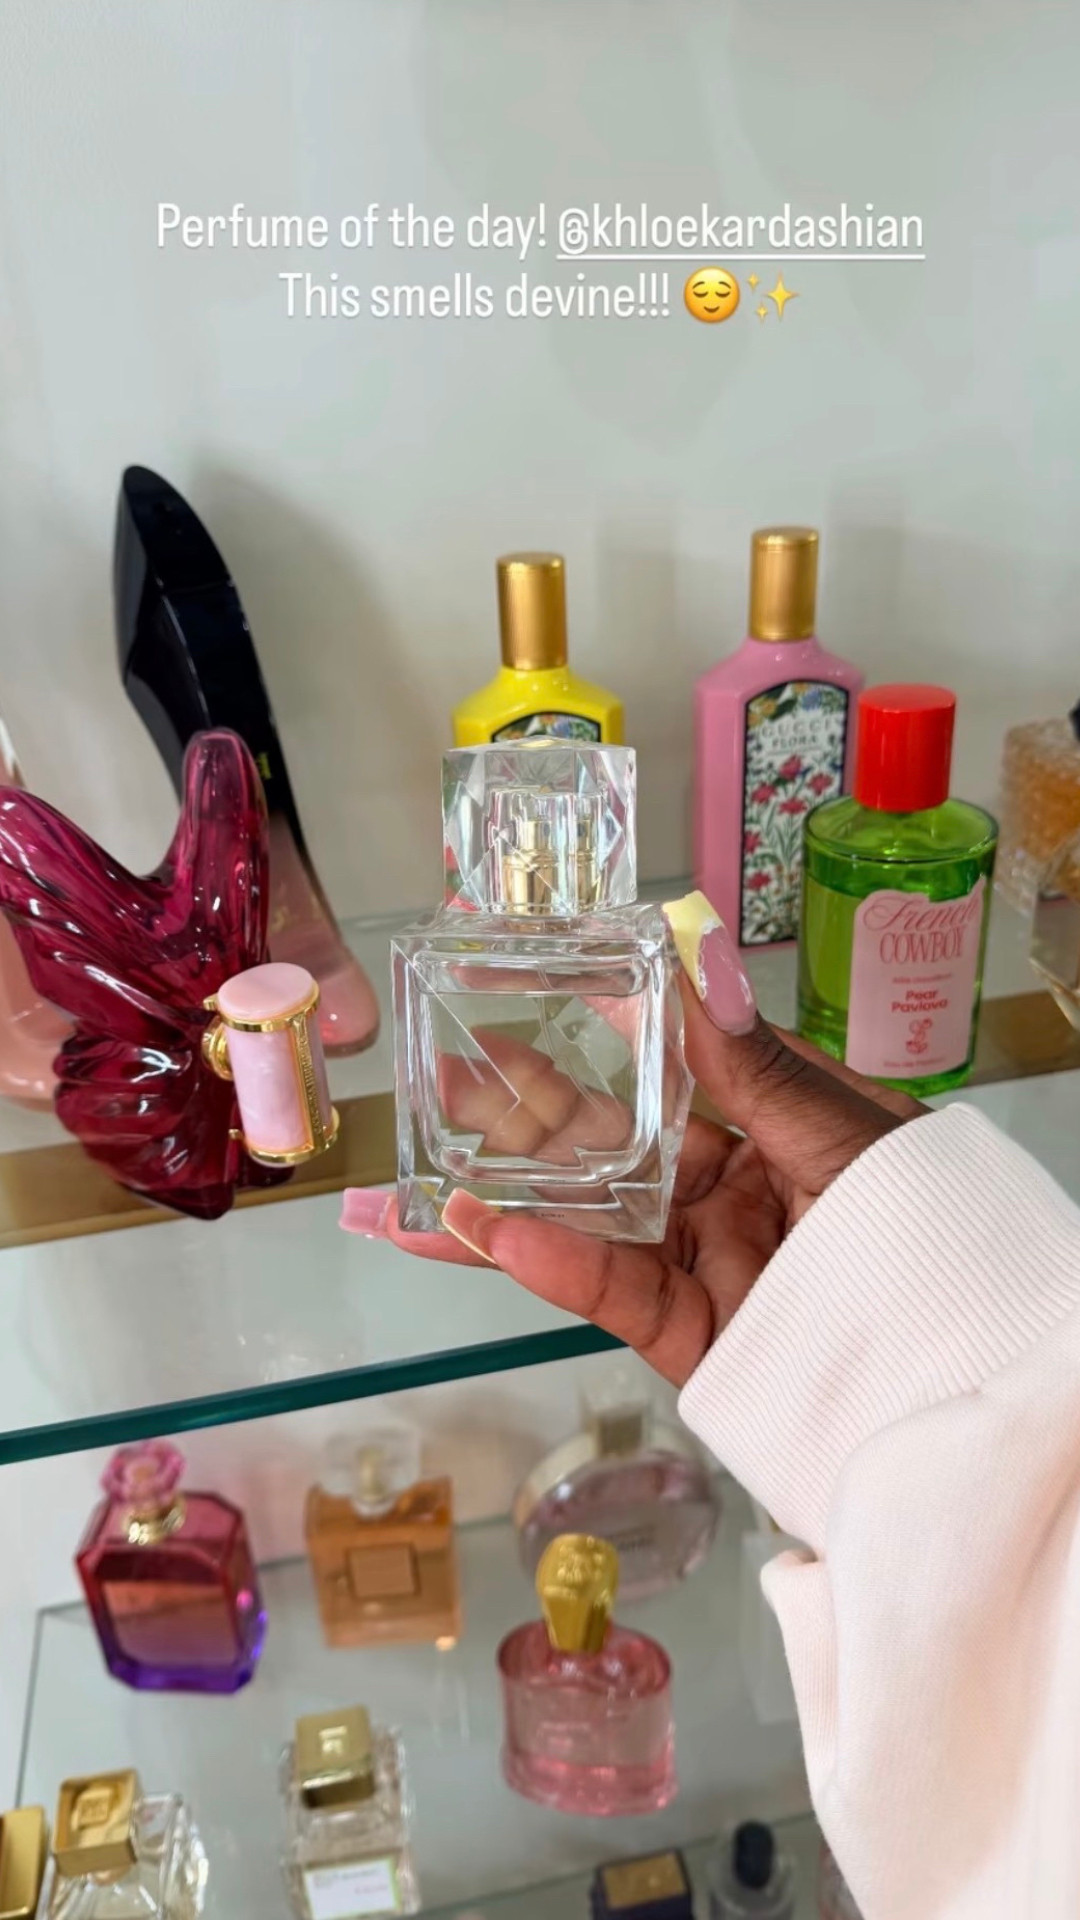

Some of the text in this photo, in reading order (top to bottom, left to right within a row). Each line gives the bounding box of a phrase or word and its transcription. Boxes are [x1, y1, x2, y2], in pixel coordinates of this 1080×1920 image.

[761, 718, 830, 739] GUCCI
[771, 734, 818, 749] FLORA
[863, 896, 980, 932] French
[880, 923, 967, 964] COWBOY
[905, 989, 938, 1001] Pear
[891, 998, 949, 1013] Pavlova
